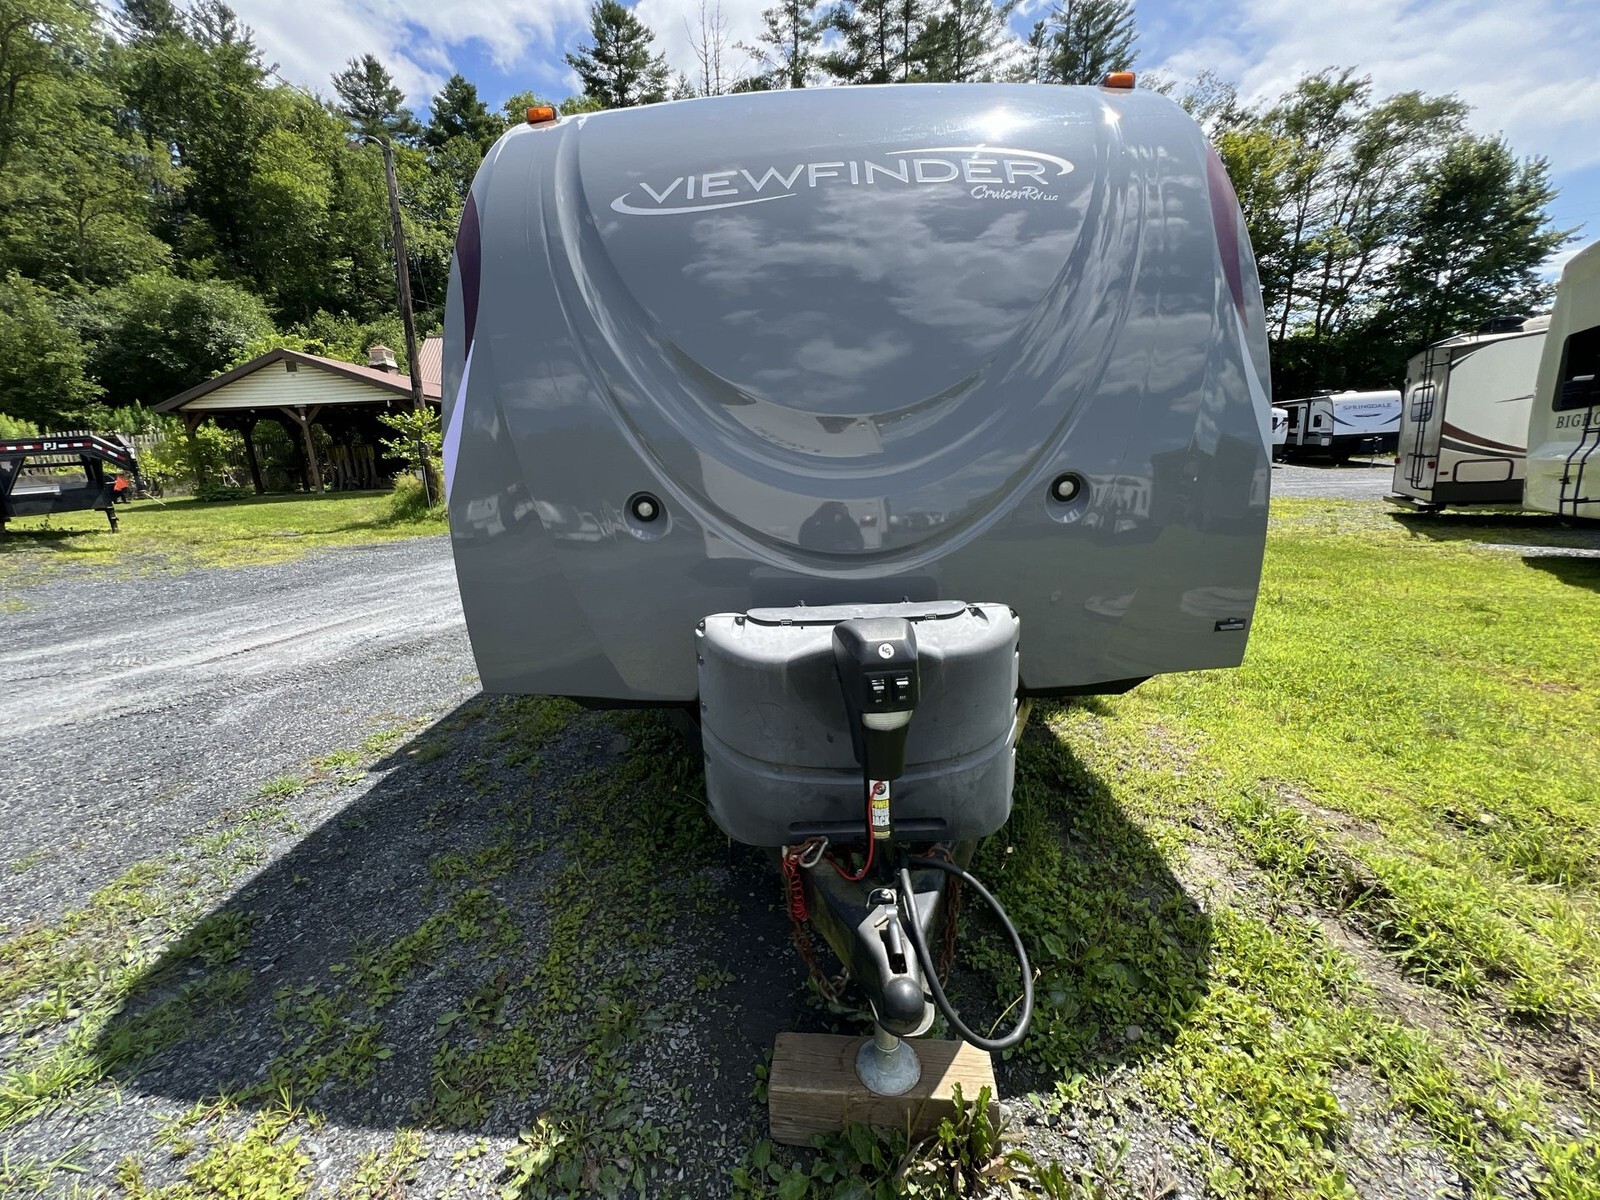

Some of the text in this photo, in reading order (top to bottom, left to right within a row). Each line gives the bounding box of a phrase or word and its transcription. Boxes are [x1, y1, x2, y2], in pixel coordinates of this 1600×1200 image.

[639, 157, 1049, 204] VIEWFINDER
[1343, 402, 1392, 411] SPRINGDALE
[43, 442, 57, 451] PJ
